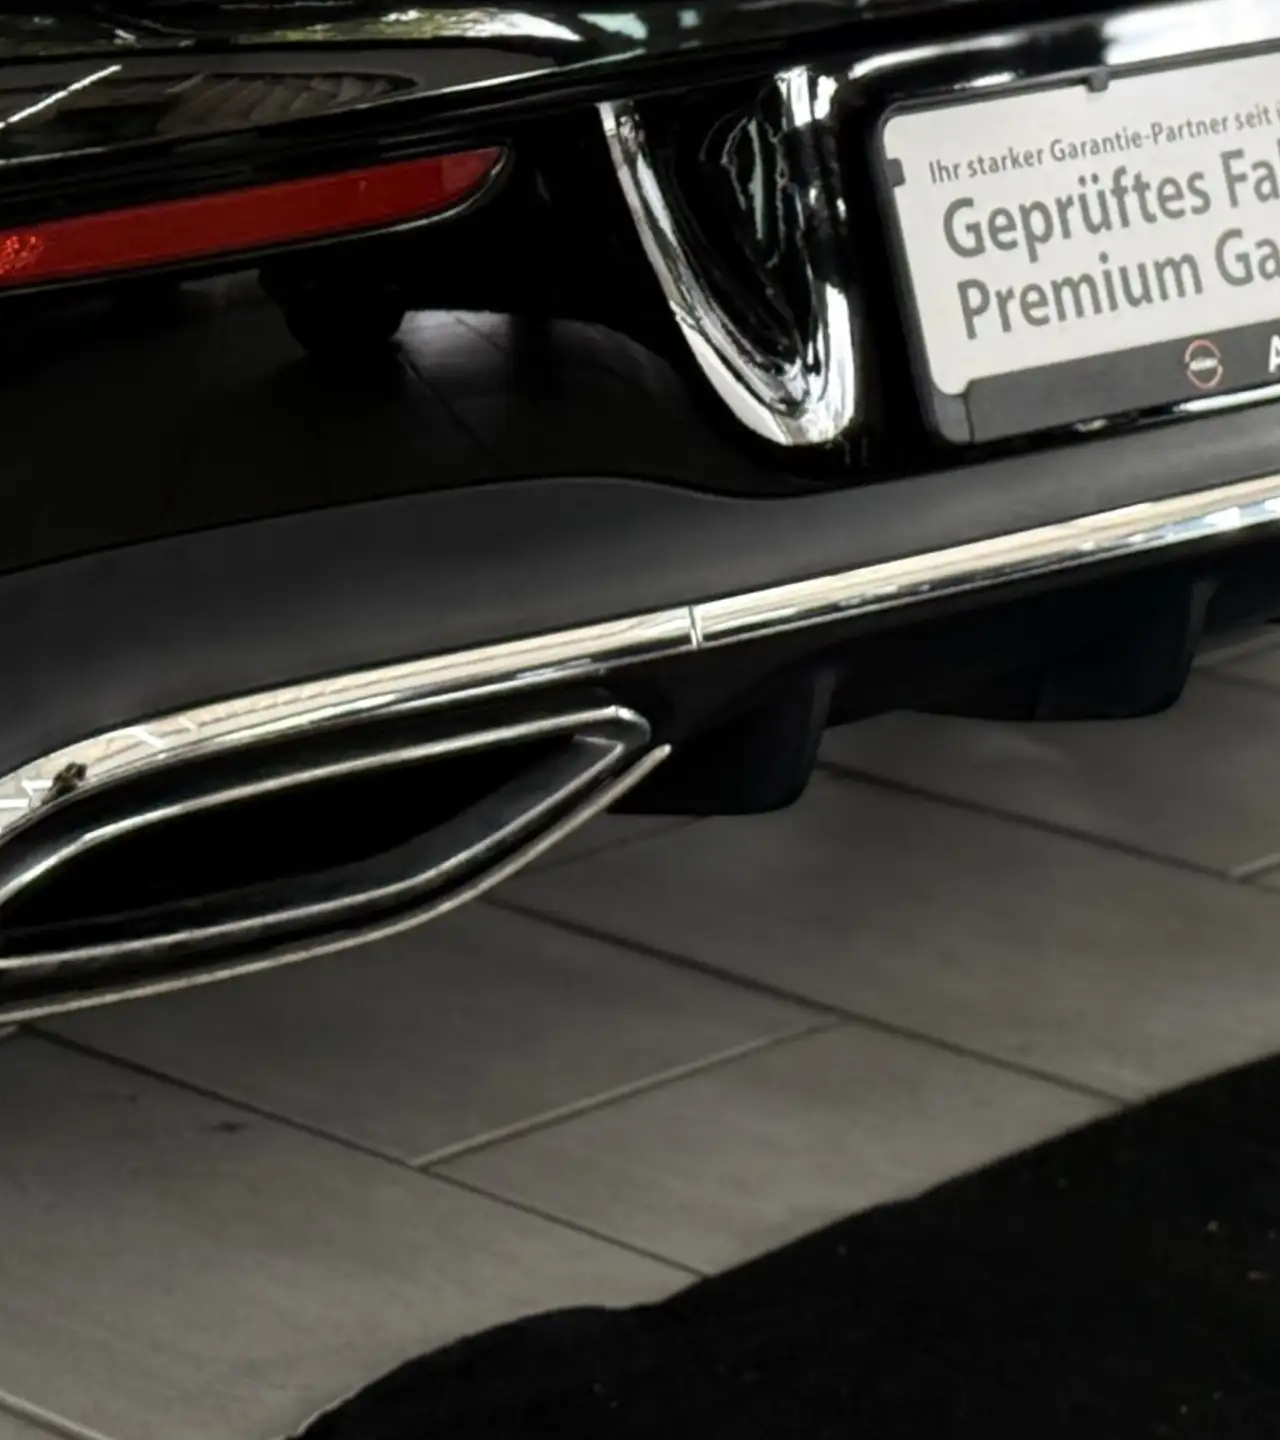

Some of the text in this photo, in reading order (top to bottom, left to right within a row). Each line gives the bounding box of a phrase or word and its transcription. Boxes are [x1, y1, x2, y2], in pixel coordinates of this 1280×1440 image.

[928, 159, 961, 184] Ihr
[967, 147, 1044, 178] starker
[1050, 115, 1229, 162] Garantie-Partner
[1234, 103, 1273, 131] seit
[942, 164, 1212, 262] Geprüftes
[956, 251, 1204, 340] Premium
